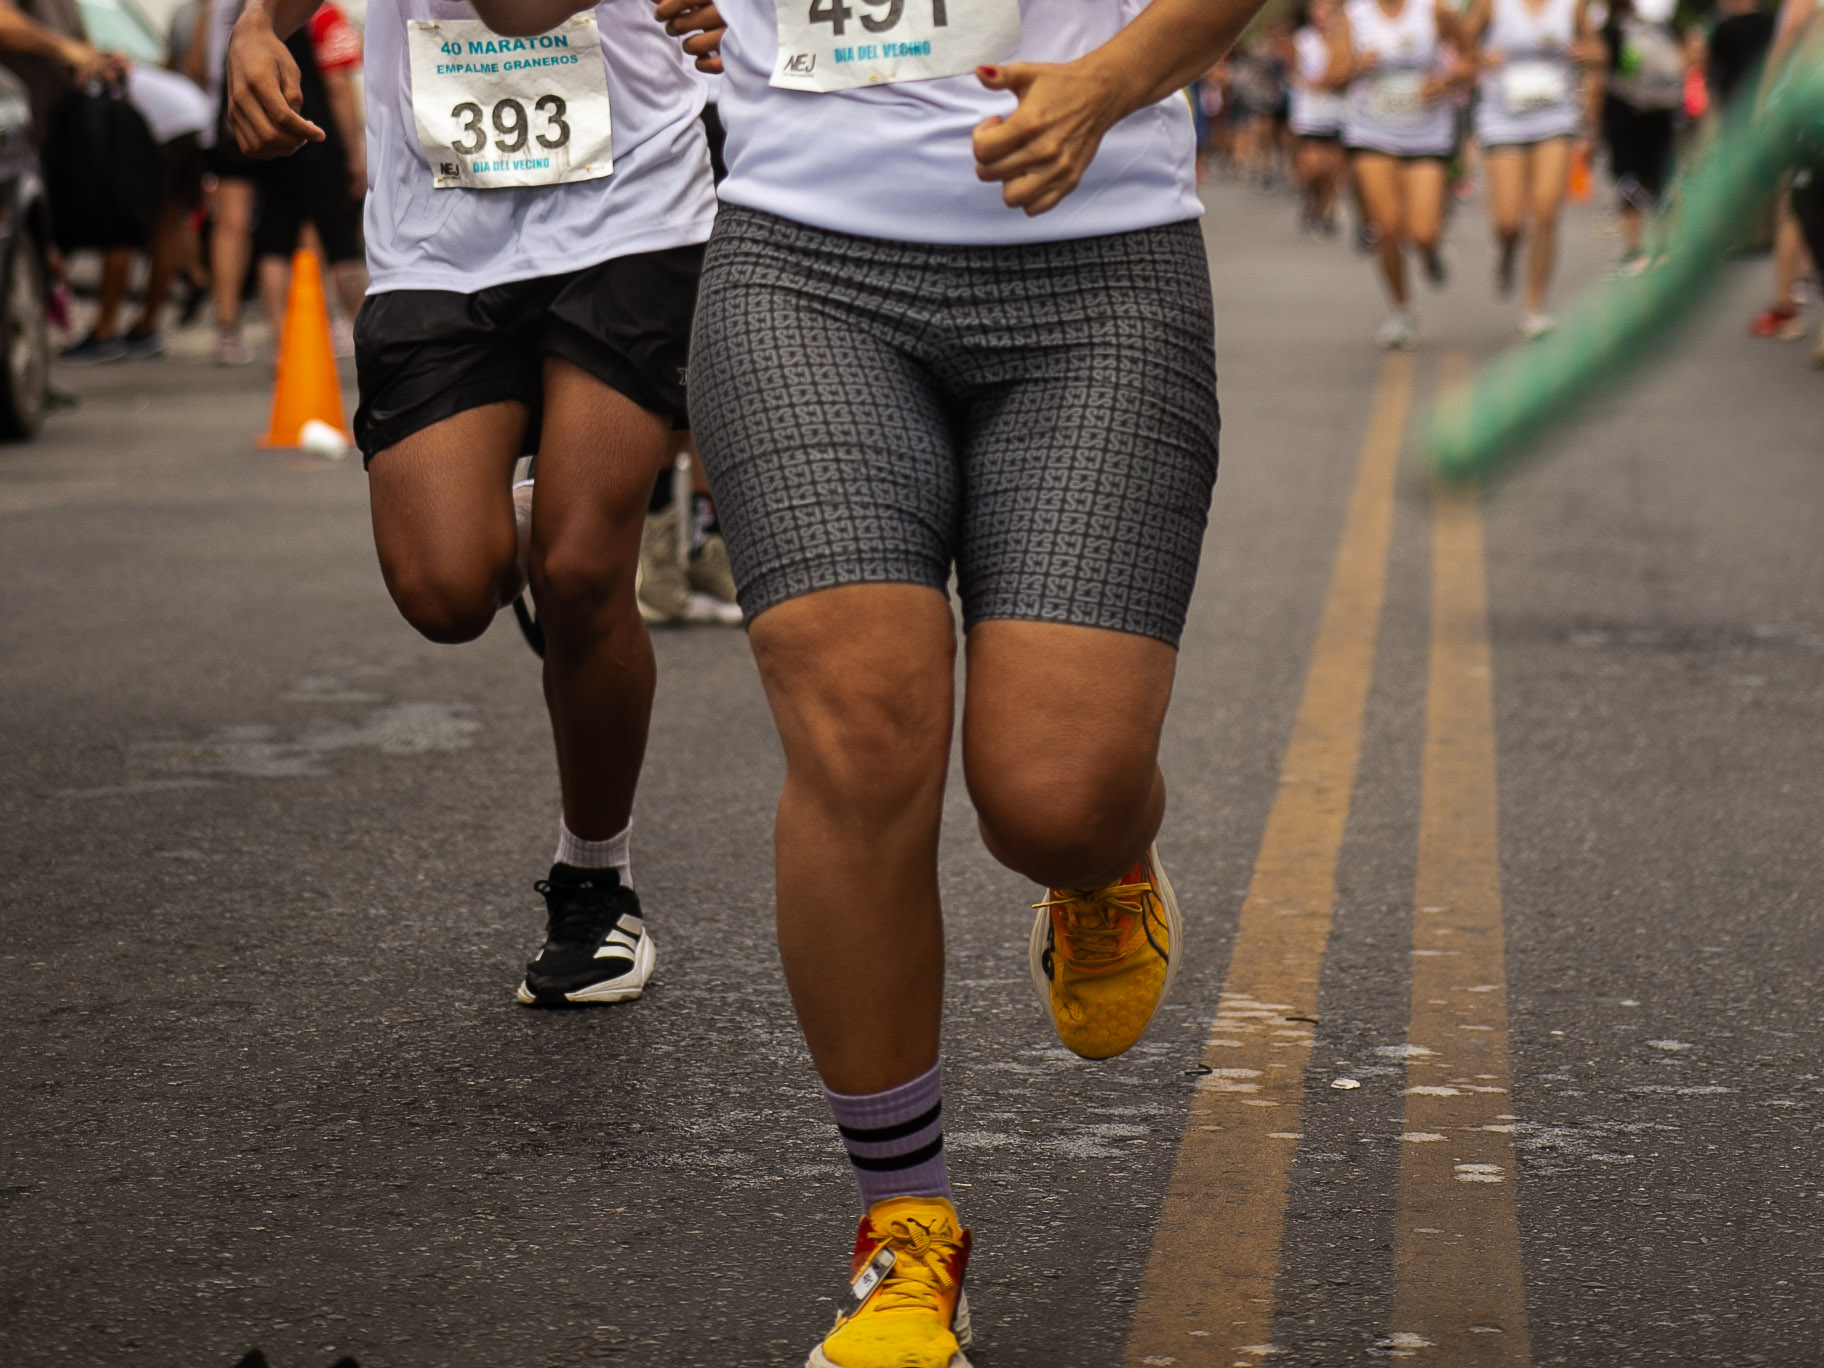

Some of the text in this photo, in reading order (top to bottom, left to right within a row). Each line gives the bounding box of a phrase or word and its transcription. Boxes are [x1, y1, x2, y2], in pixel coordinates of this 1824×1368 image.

[440, 34, 569, 55] 40 MARATON
[834, 40, 931, 63] DIA DEL VECINO
[437, 54, 578, 74] EMPALME GRANEROS
[783, 53, 816, 73] NEJ
[450, 94, 571, 155] 393
[440, 162, 460, 177] NEJ
[472, 157, 550, 173] DIA DEL VECINO
